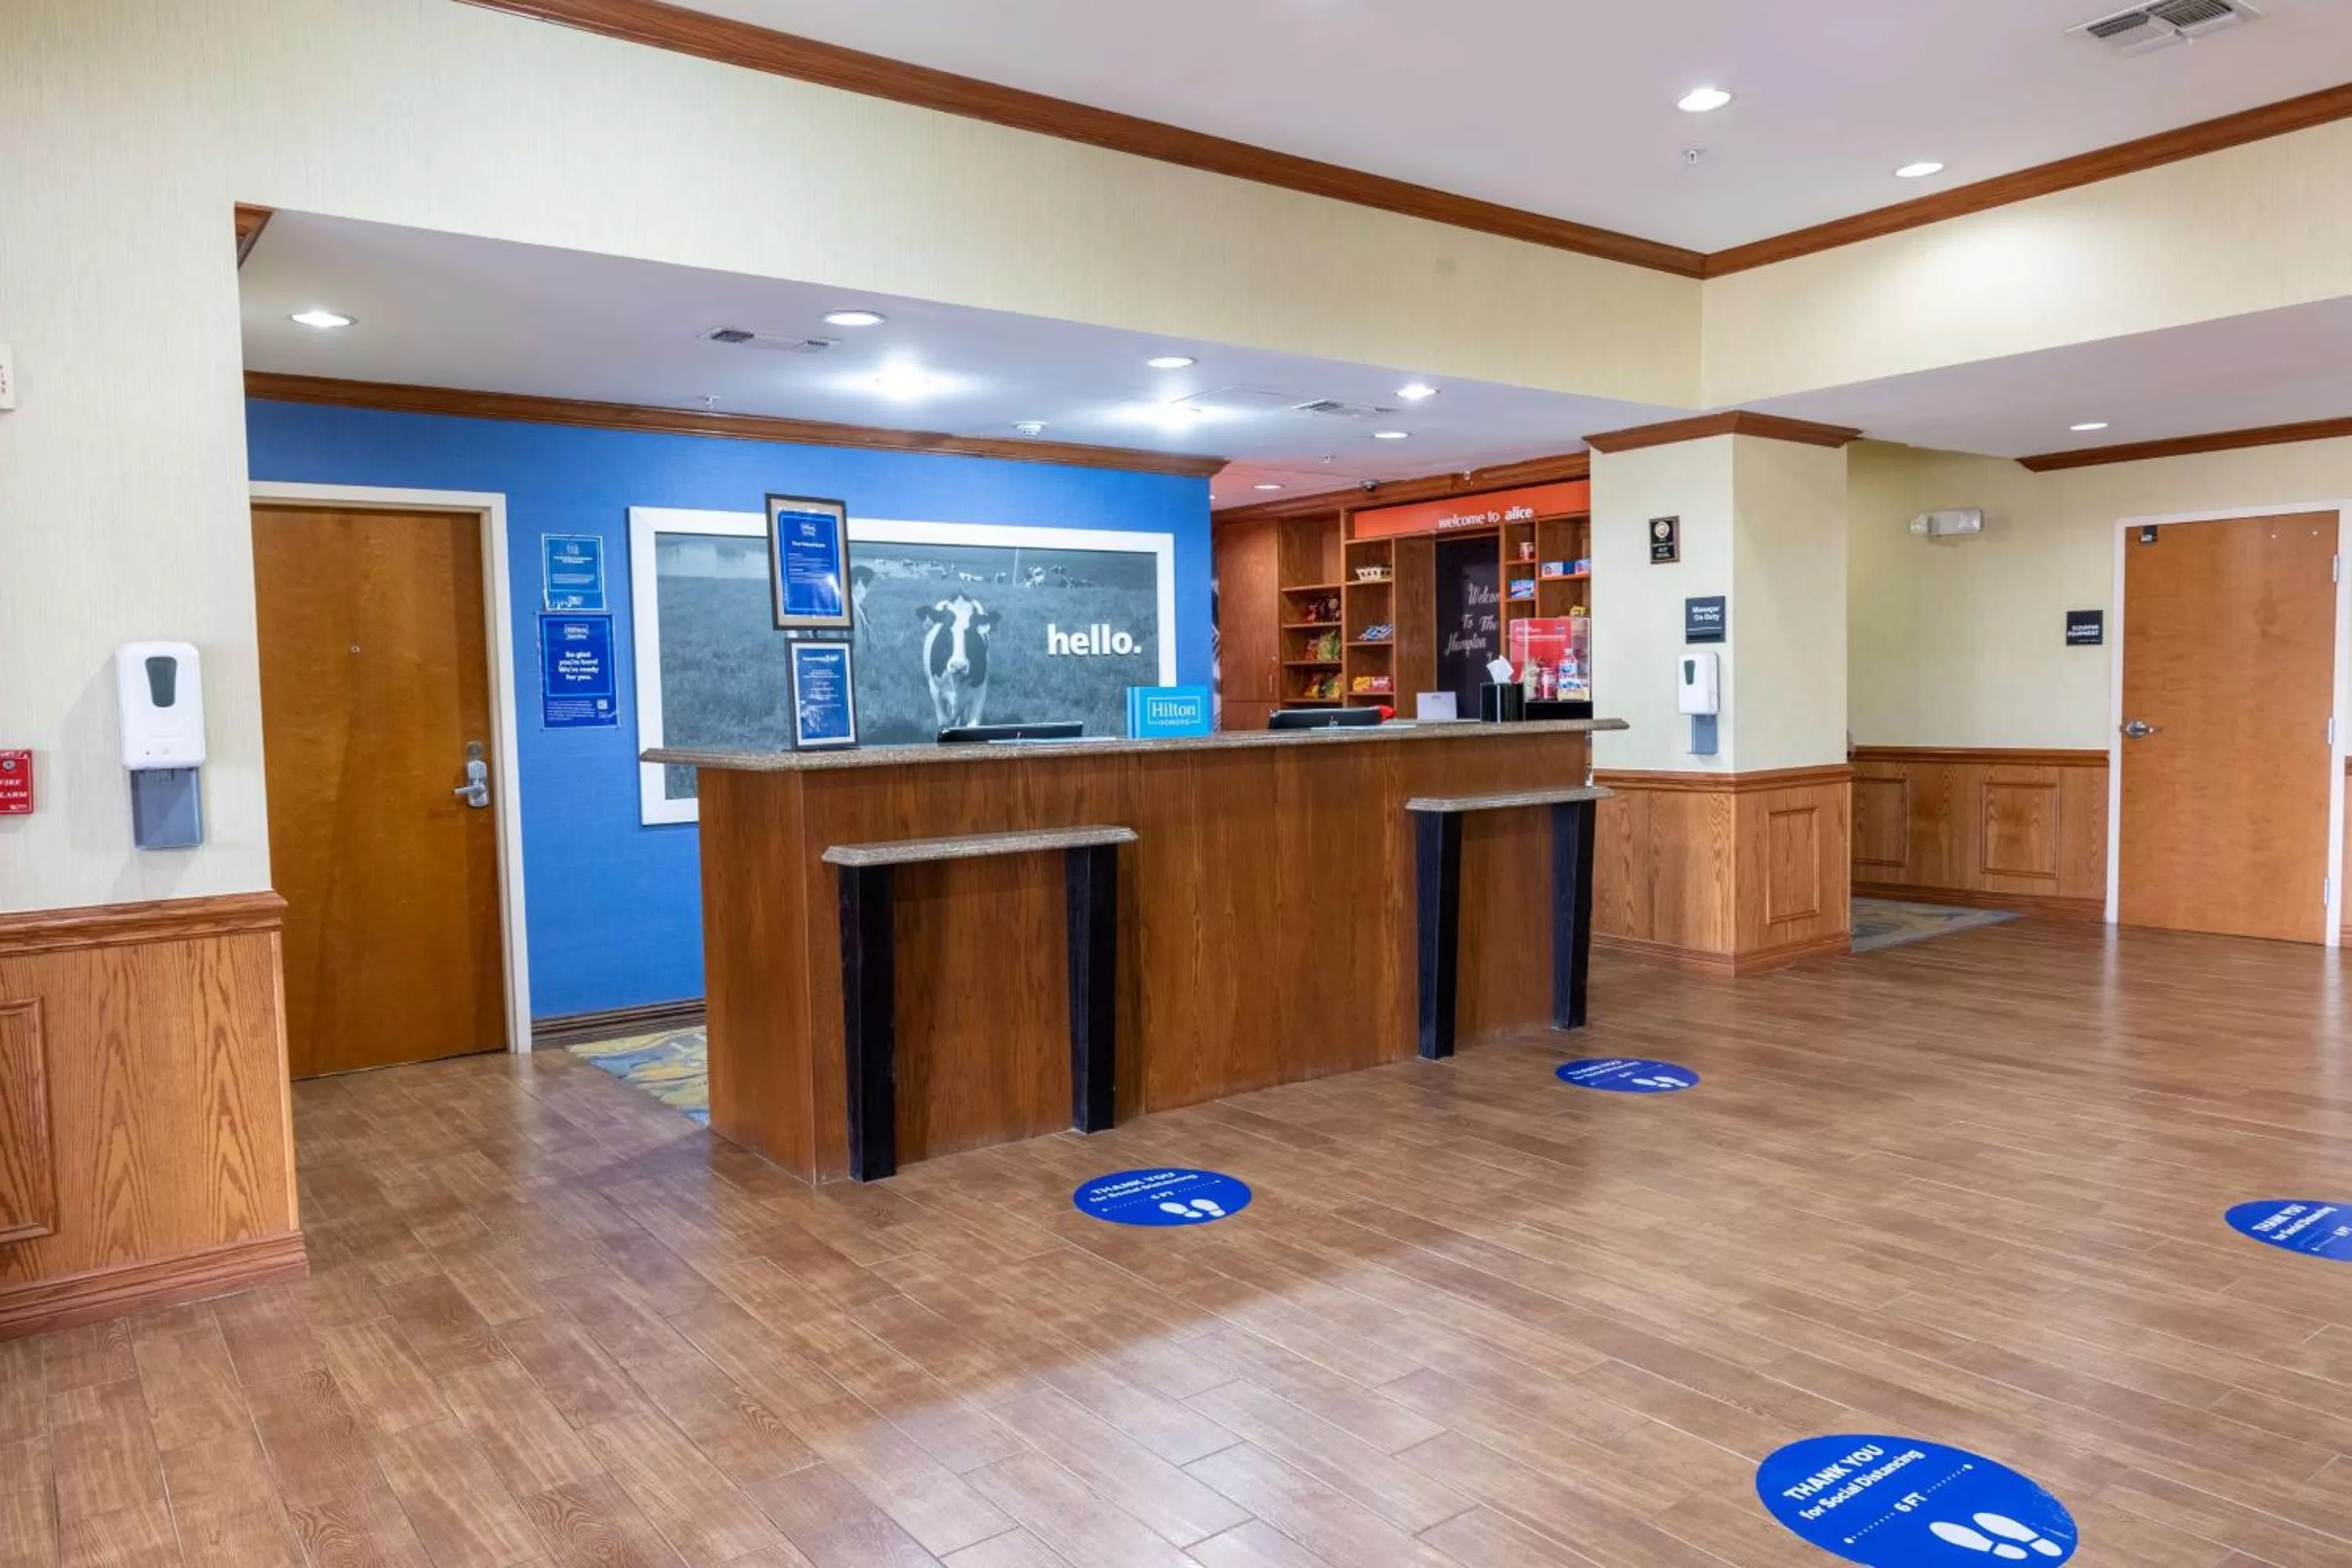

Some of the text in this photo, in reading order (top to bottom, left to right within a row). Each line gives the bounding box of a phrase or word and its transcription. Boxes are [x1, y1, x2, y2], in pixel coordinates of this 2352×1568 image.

[1439, 506, 1534, 528] welcome to alice
[1468, 583, 1500, 605] Welco
[1461, 612, 1475, 630] To
[1704, 613, 1721, 622] Duty
[1047, 623, 1142, 655] hello.
[1152, 702, 1196, 717] Hilton
[1782, 1443, 1884, 1500] THANK YOU
[1798, 1450, 1926, 1520] for Social Distancing
[1894, 1492, 1929, 1512] 6 FT
